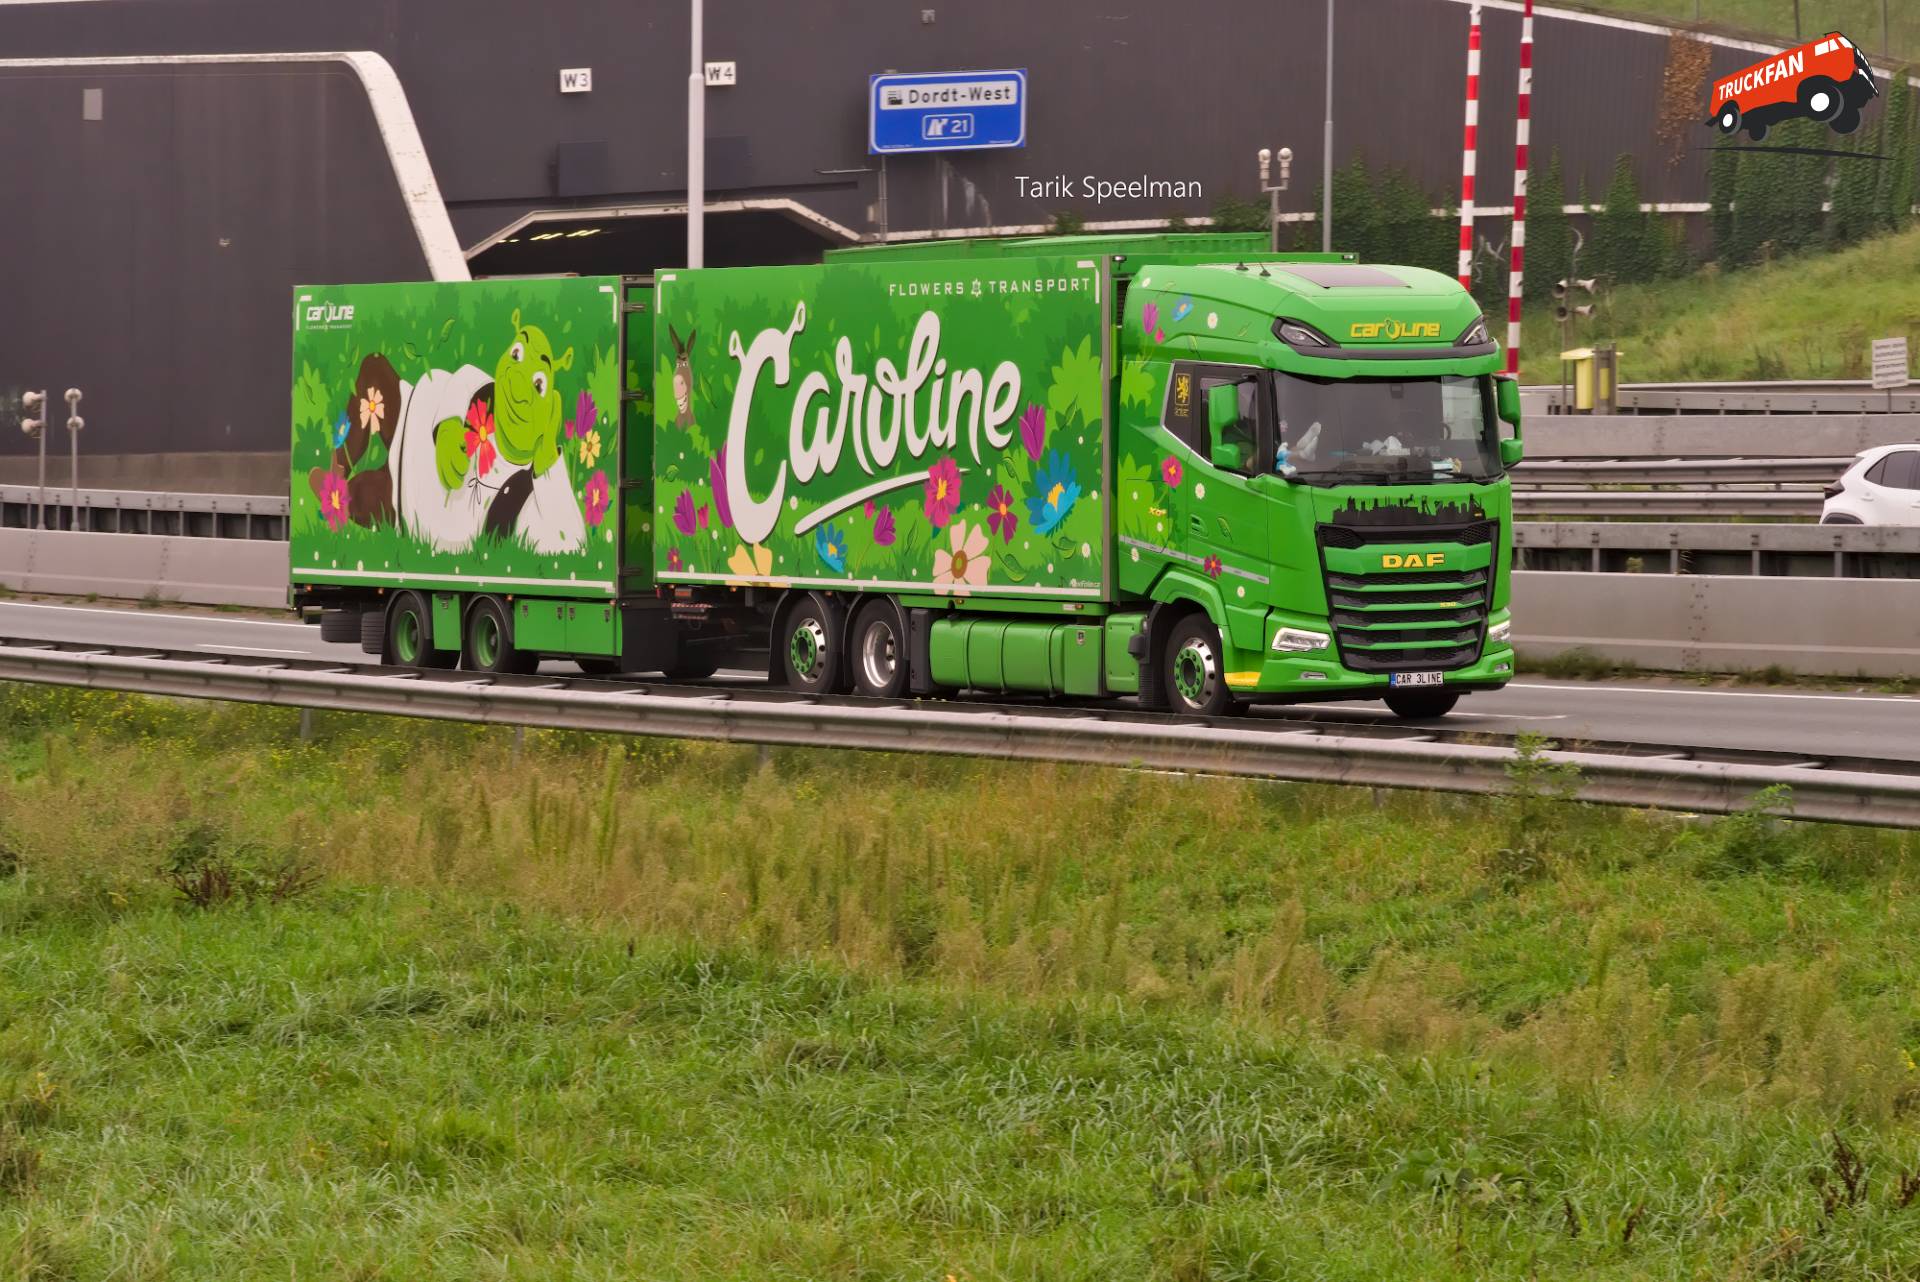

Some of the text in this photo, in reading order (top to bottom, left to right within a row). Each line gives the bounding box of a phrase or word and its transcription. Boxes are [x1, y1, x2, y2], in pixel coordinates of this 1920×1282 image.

[563, 73, 589, 88] W3
[708, 66, 733, 81] W4
[908, 86, 1011, 104] Dordt-West
[951, 119, 968, 133] 21
[889, 277, 1090, 297] FLOWERS TRANSPORT
[726, 300, 1022, 545] Caroline
[1382, 553, 1445, 568] DAF
[1396, 672, 1442, 685] CAR 3LINE
